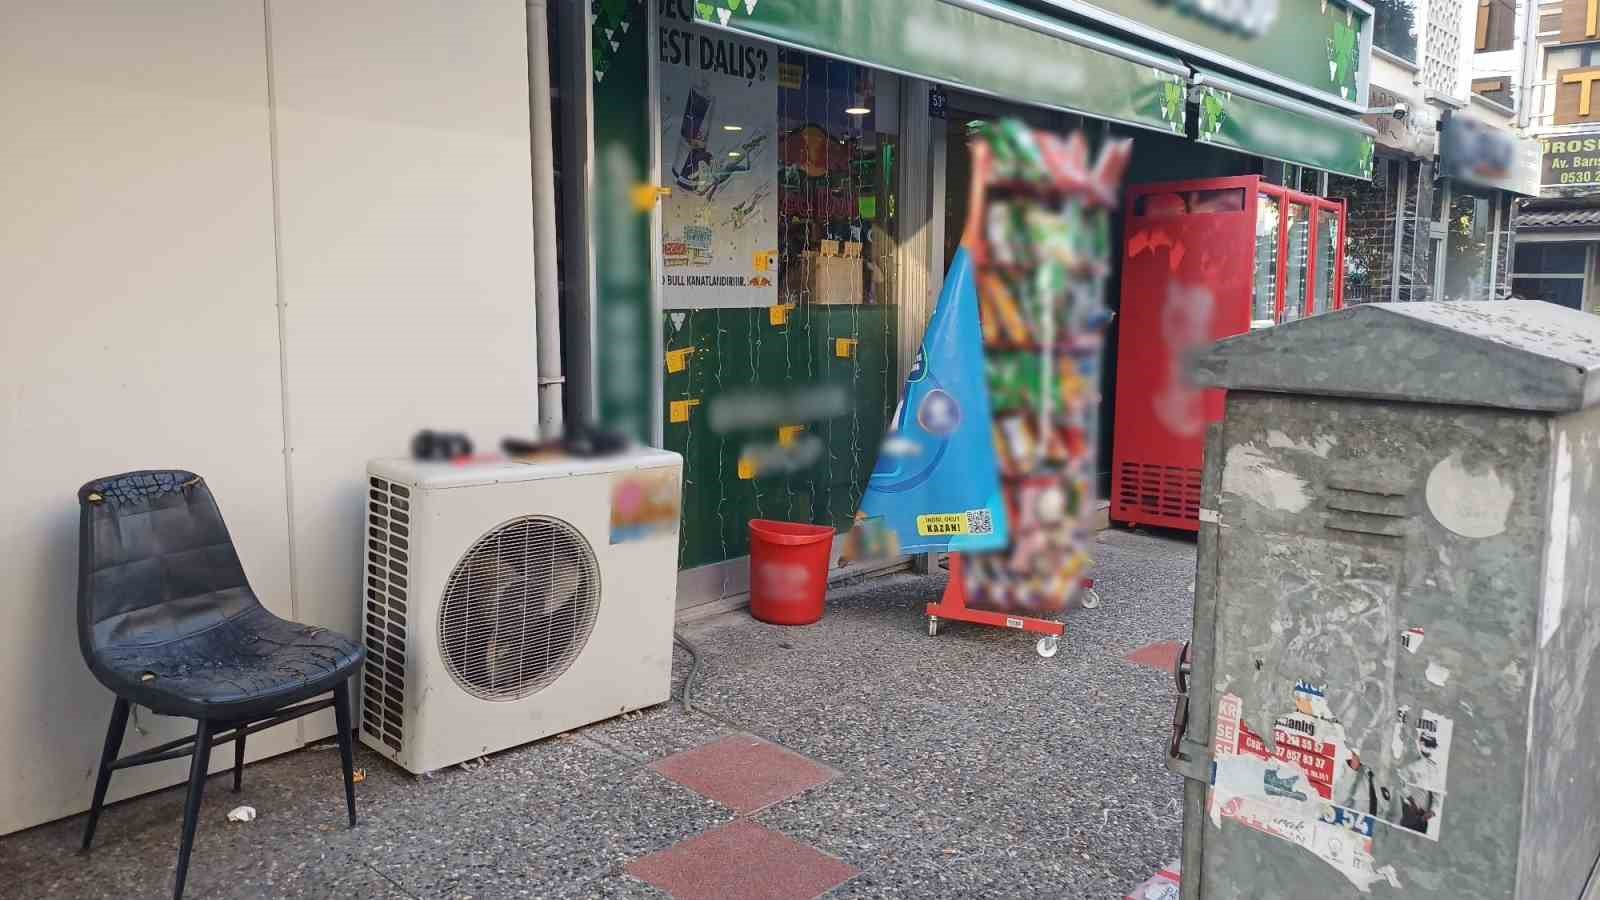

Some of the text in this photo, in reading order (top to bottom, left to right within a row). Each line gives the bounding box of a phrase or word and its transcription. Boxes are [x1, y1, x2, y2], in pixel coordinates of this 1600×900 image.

[699, 35, 768, 87] DALIŞ?
[1551, 158, 1569, 169] Av.
[1560, 171, 1591, 184] 0530
[667, 274, 685, 287] BULL
[927, 523, 961, 533] KAZAN!
